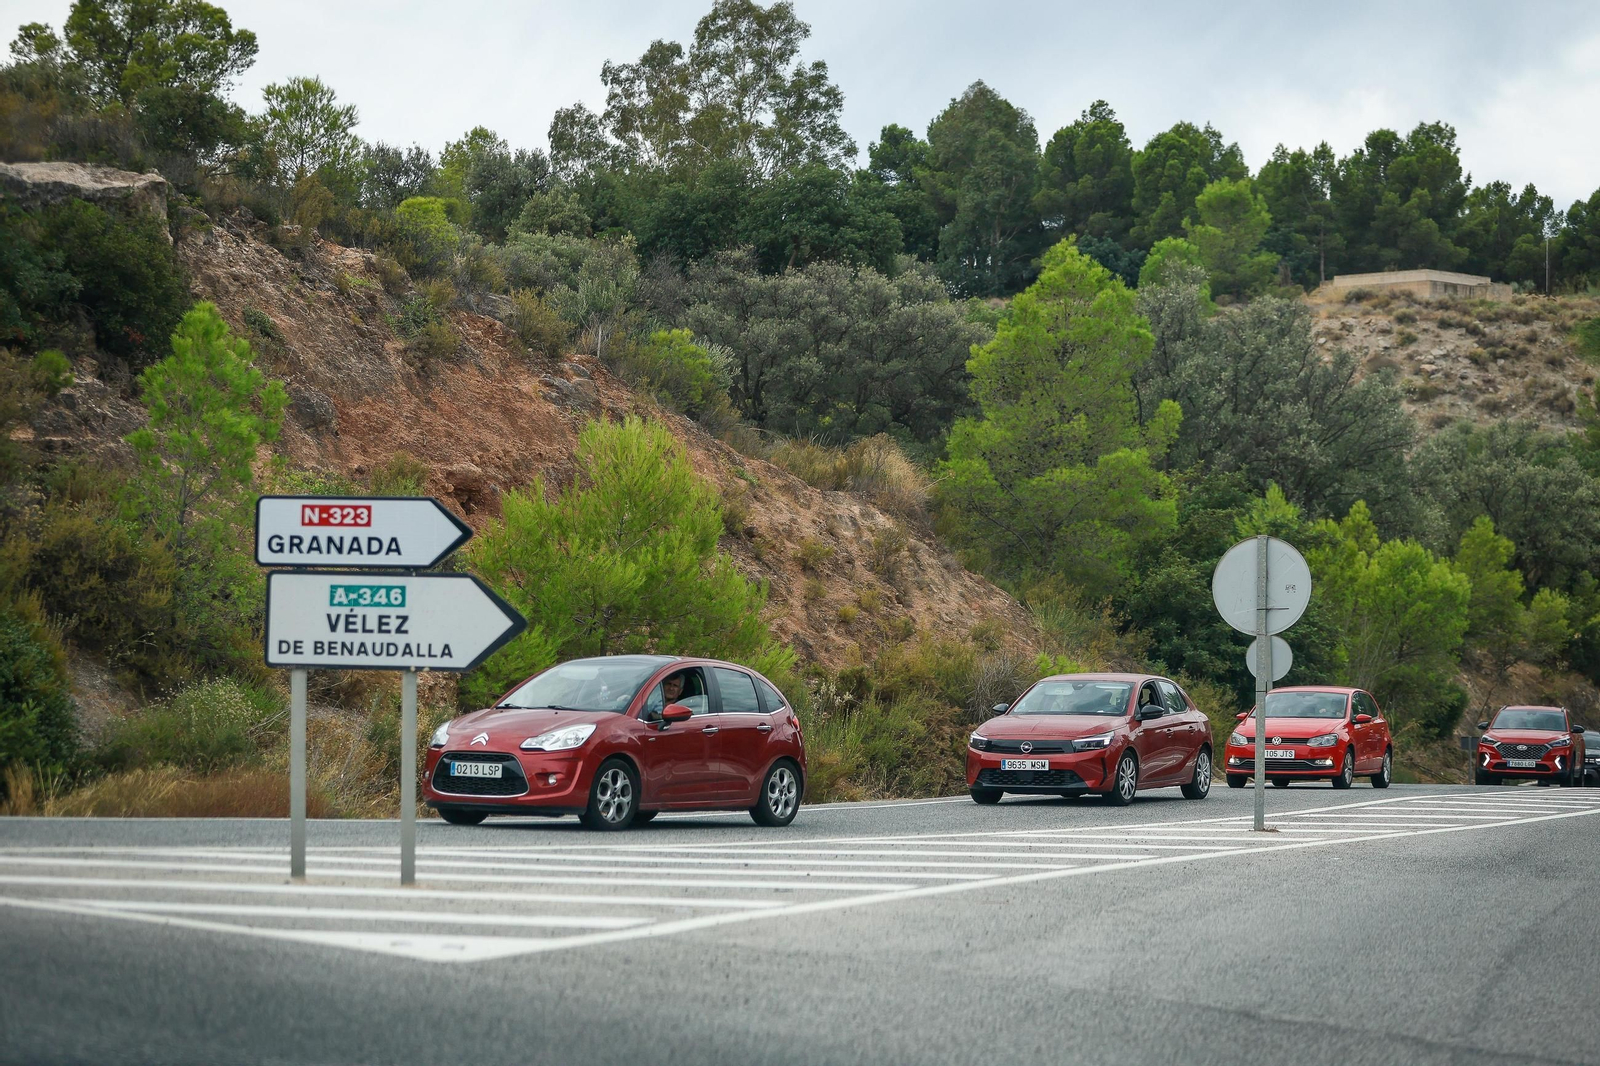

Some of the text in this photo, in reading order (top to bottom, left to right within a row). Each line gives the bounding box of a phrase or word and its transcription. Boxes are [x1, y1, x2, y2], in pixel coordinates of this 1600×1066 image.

[304, 507, 369, 524] N-323
[267, 534, 402, 556] GRANADA
[333, 588, 403, 606] A-346
[327, 608, 409, 635] VÉLEZ
[278, 640, 453, 659] DE BENAUDALLA
[1280, 750, 1293, 758] JTS
[456, 763, 500, 776] 0213 LSP
[1007, 760, 1046, 769] 9635 MSM
